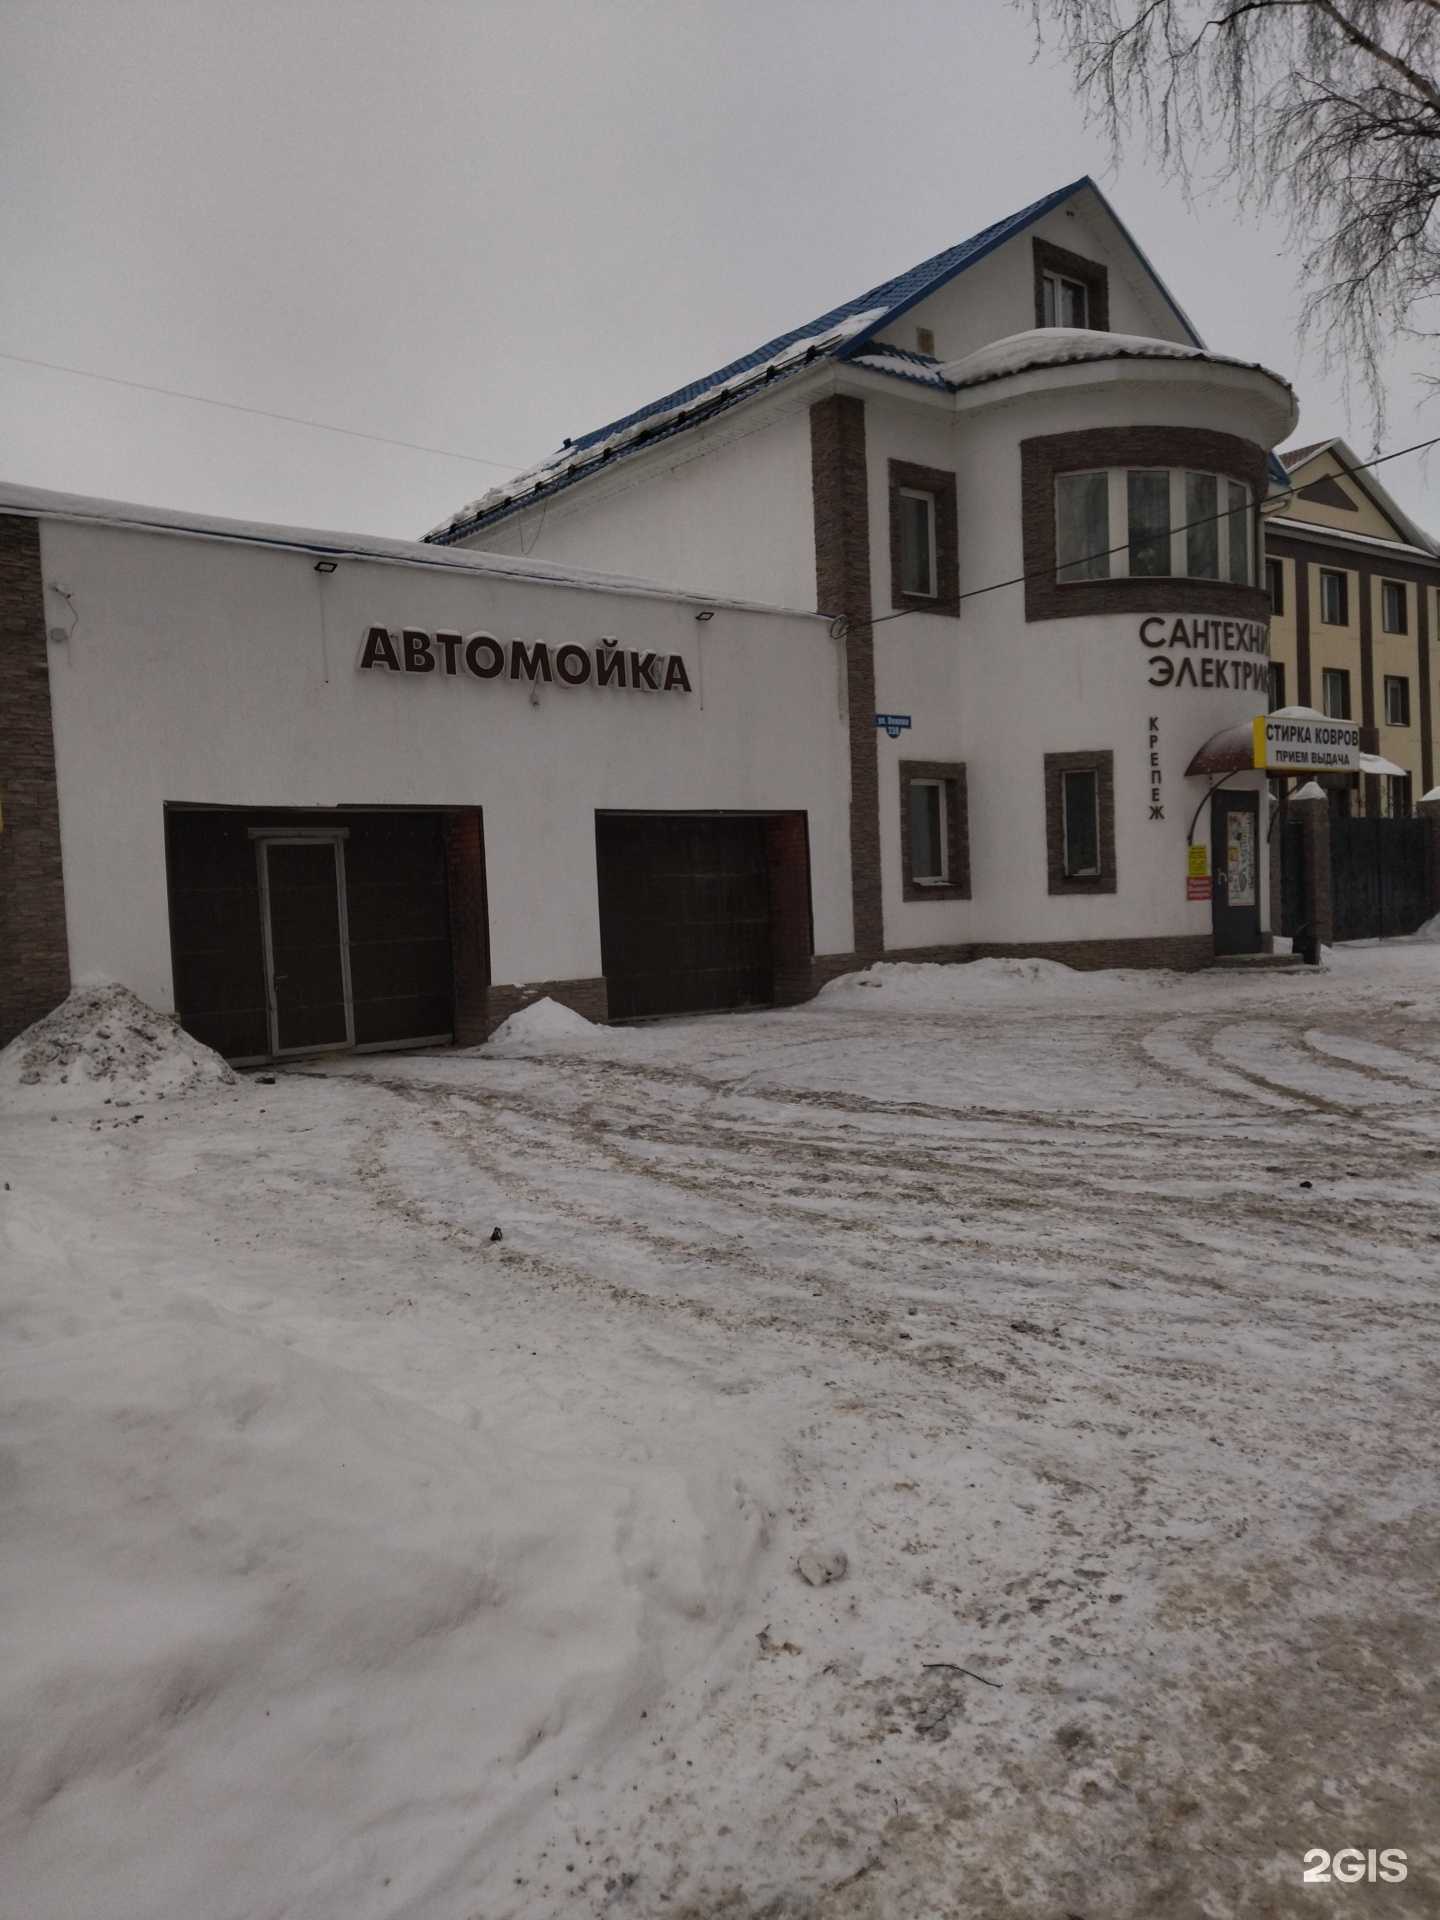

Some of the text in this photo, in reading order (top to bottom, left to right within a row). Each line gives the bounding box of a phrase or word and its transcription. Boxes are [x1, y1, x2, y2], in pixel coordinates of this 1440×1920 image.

[360, 626, 692, 692] АВТОМОЙКА
[1266, 724, 1359, 747] СТИРКА КОВРОВ
[1148, 716, 1165, 820] КРЕПЕЖ
[1275, 750, 1350, 766] ПРИЕМ ВЫДАЧА
